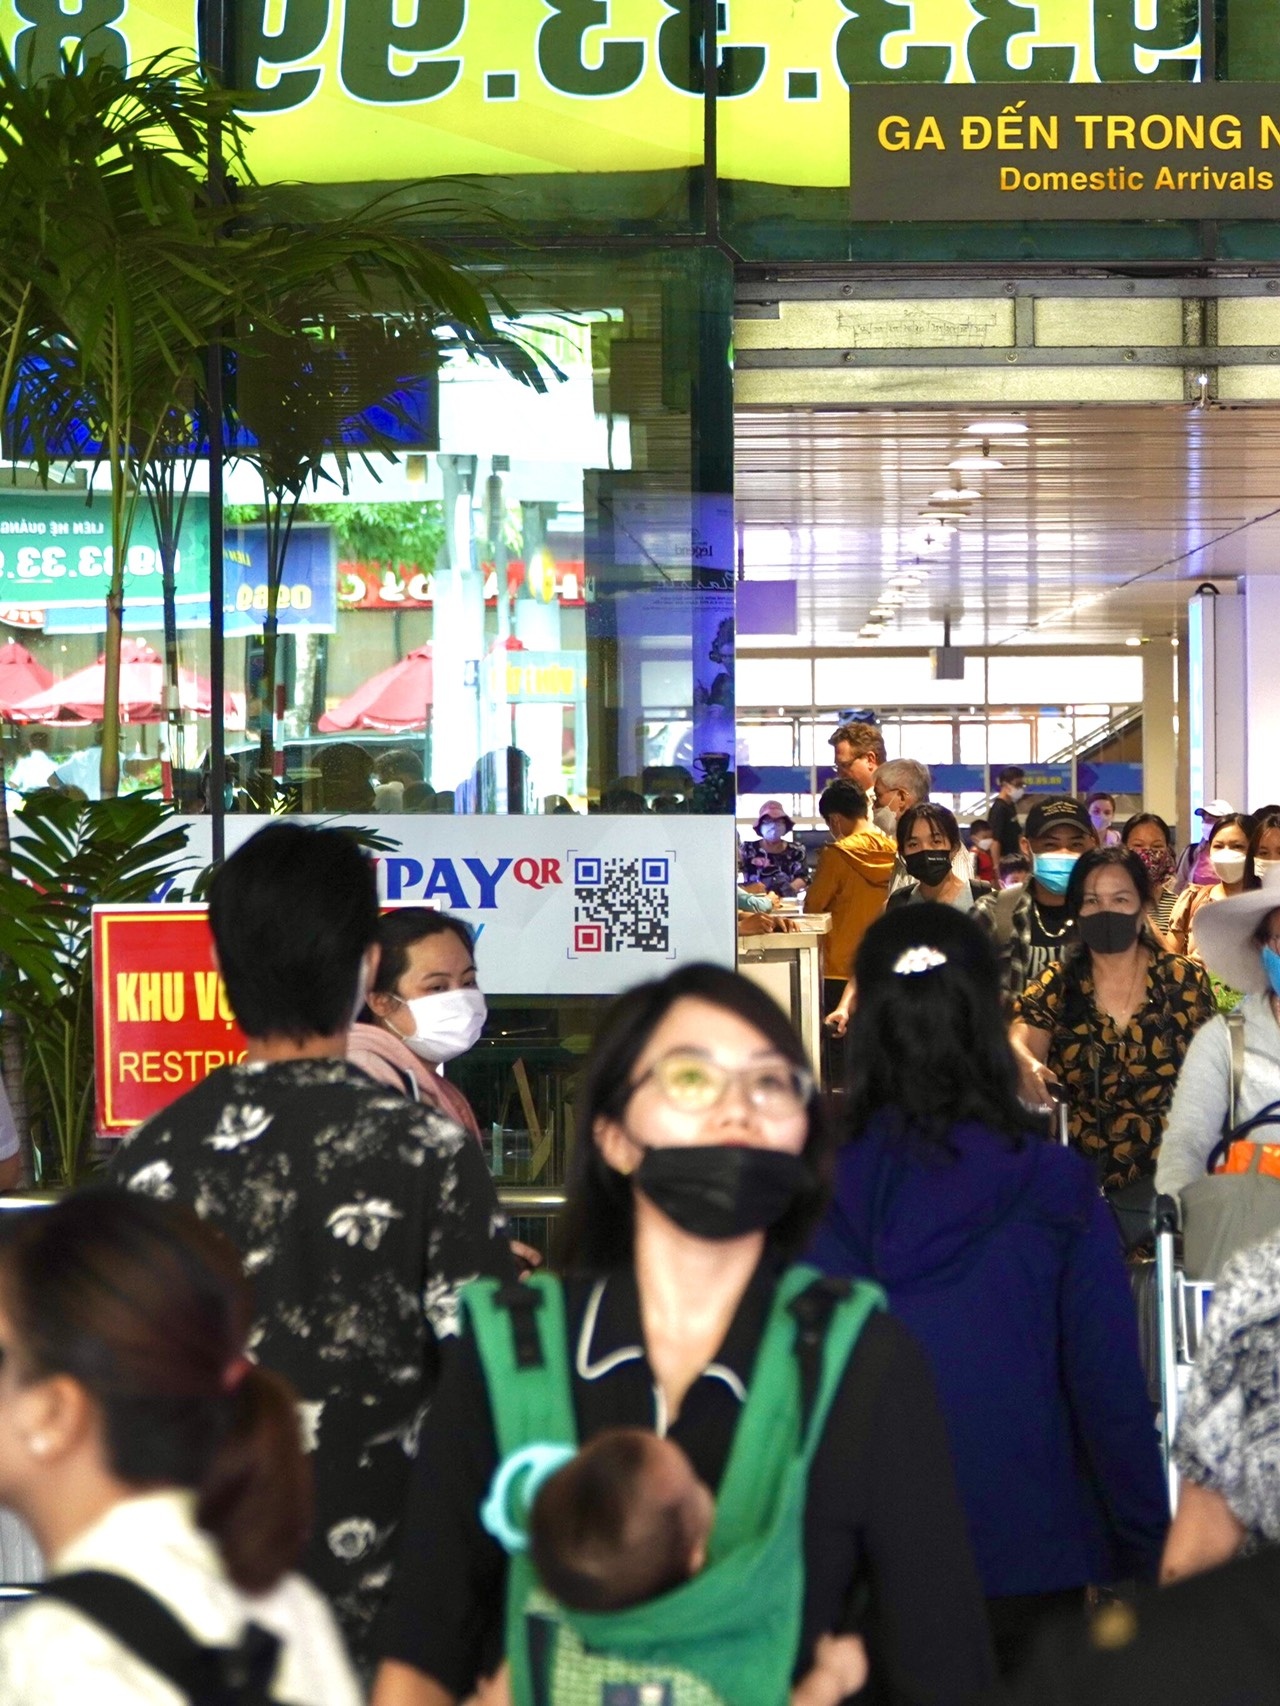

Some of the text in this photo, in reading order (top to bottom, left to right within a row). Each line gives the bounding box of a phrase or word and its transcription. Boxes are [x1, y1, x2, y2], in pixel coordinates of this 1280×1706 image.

[877, 114, 946, 151] GA
[961, 100, 1059, 150] ĐẾN
[1075, 114, 1242, 150] TRONG
[1000, 166, 1274, 191] Domestic Arrivals
[116, 971, 186, 1023] KHU
